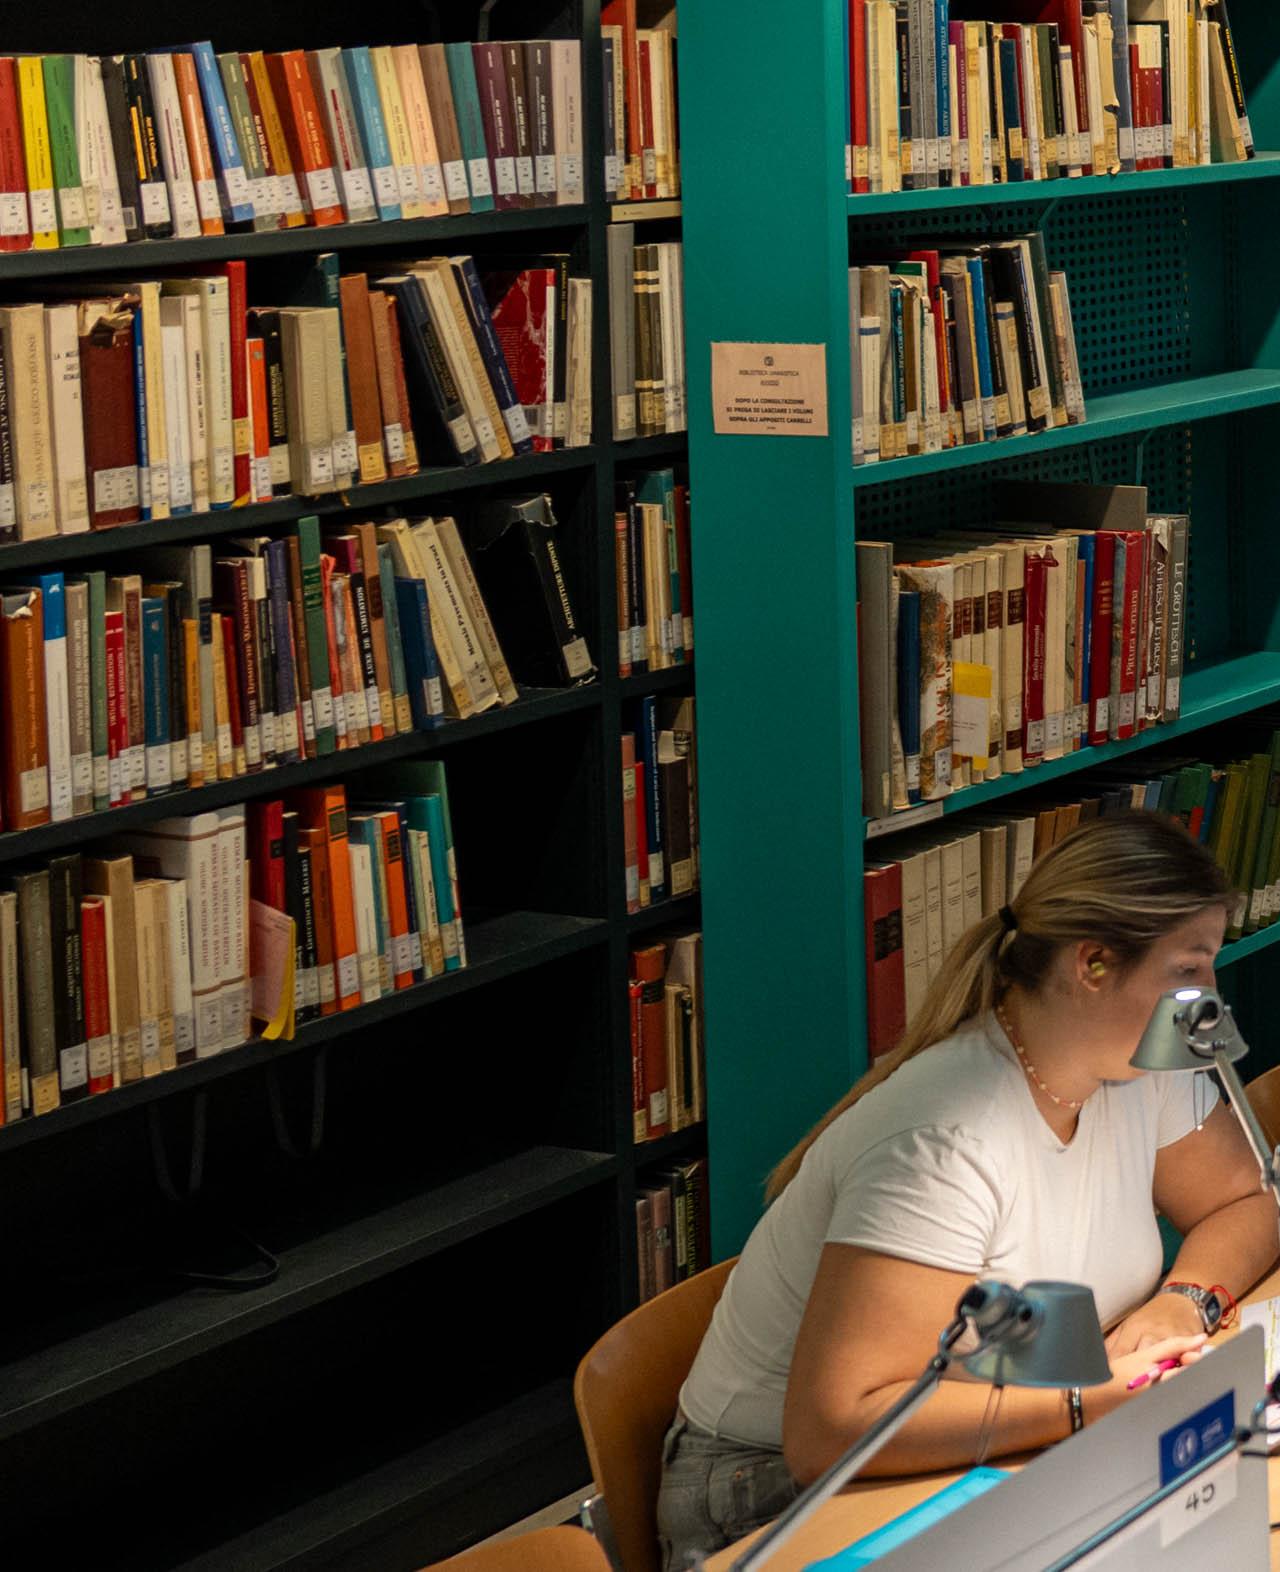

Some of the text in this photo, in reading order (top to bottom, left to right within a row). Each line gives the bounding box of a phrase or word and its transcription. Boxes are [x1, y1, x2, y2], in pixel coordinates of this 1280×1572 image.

[429, 544, 444, 569] Israel
[444, 580, 465, 626] Pavements
[546, 540, 575, 629] ARCHITETTURE DIPINTE
[1154, 561, 1166, 624] AFFRESCHI
[356, 587, 369, 633] L'IMITATION
[1126, 590, 1138, 675] Pittura romana
[1170, 561, 1184, 666] LE GROTTESCHE
[363, 638, 371, 648] DE
[365, 653, 374, 674] LUXE
[461, 627, 476, 656] Mosaic
[107, 653, 115, 697] RESTORATION
[301, 859, 310, 894] MALEREI
